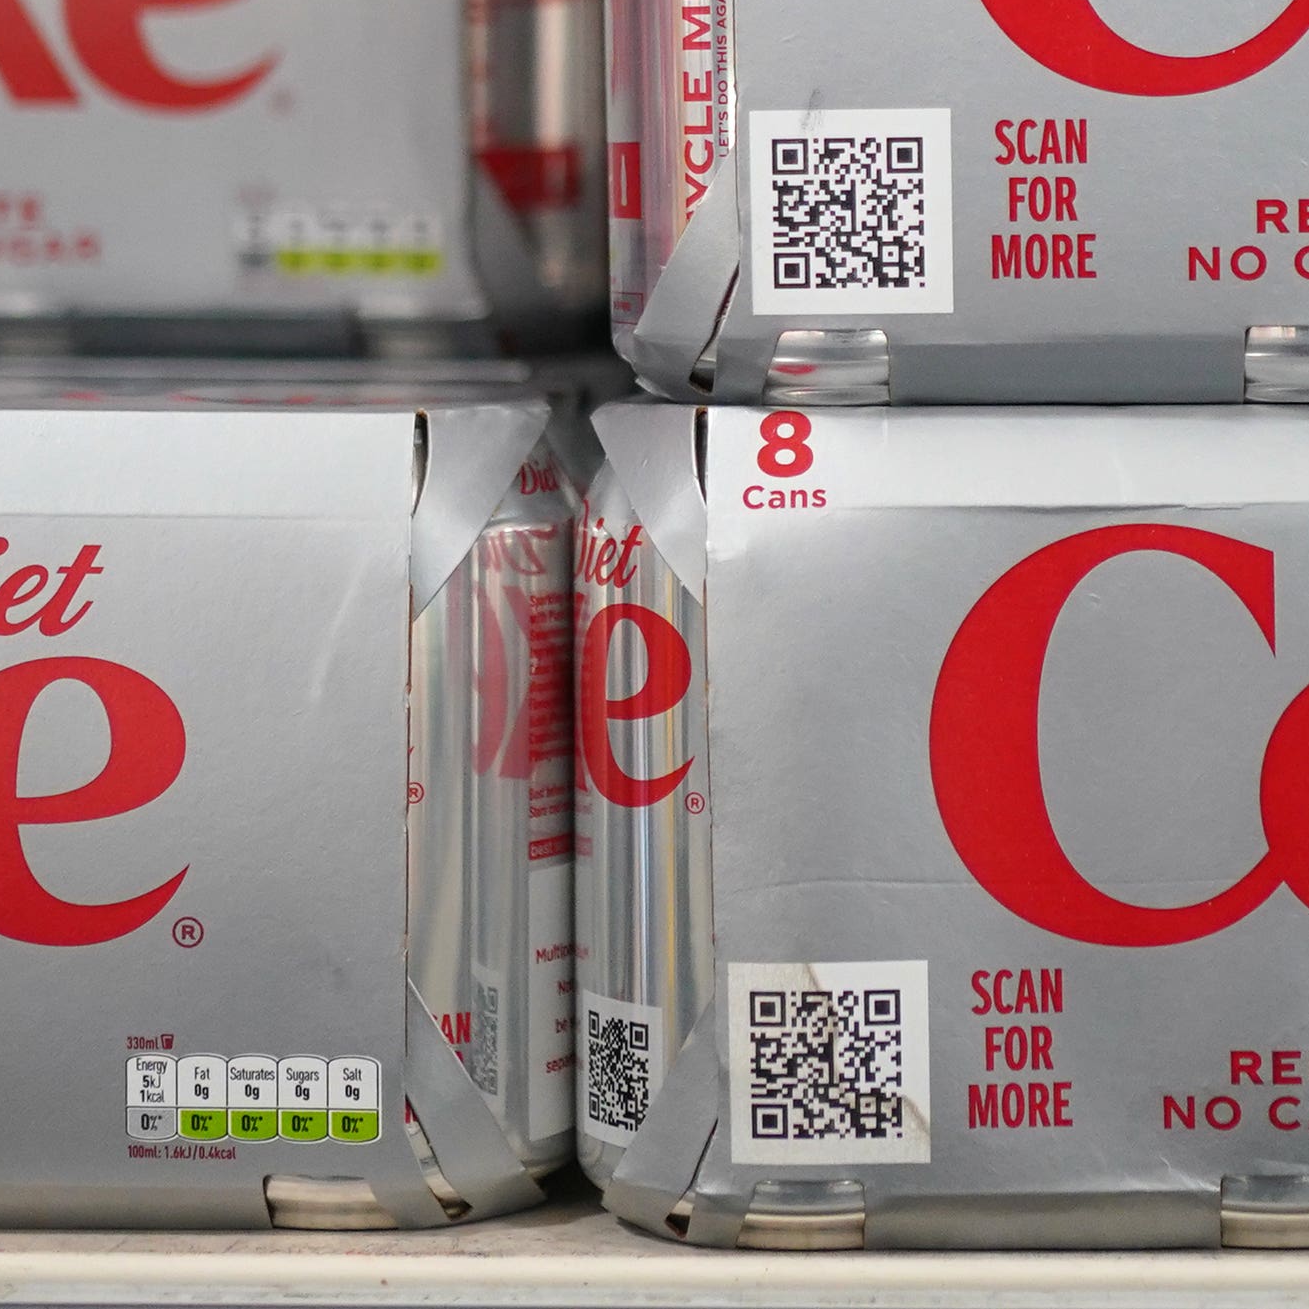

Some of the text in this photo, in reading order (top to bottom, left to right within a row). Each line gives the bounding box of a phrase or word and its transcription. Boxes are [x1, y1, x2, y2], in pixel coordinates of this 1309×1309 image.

[718, 34, 728, 80] THIS
[719, 86, 728, 111] DO
[684, 71, 714, 212] YCLE
[995, 119, 1088, 165] SCAN
[1009, 176, 1078, 222] FOR
[991, 233, 1097, 280] MORE
[1188, 244, 1267, 281] NO
[757, 410, 814, 478] 8
[742, 484, 827, 511] Cans
[971, 968, 1064, 1015] SCAN
[126, 1037, 159, 1050] 330ml
[984, 1025, 1054, 1072] FOR
[136, 1059, 167, 1074] Energy
[194, 1067, 210, 1081] Fat
[230, 1068, 275, 1081] Saturates
[286, 1069, 319, 1084] Sugars
[343, 1068, 362, 1082] Salt
[142, 1076, 161, 1089] 5kJ
[194, 1084, 209, 1100] 0g
[245, 1084, 260, 1100] 0g
[295, 1084, 310, 1101] 0g
[345, 1084, 360, 1101] 0g
[140, 1090, 165, 1103] 1kcal
[968, 1081, 1073, 1129] MORE
[1163, 1094, 1242, 1131] NO
[128, 1145, 161, 1159] 100ml:
